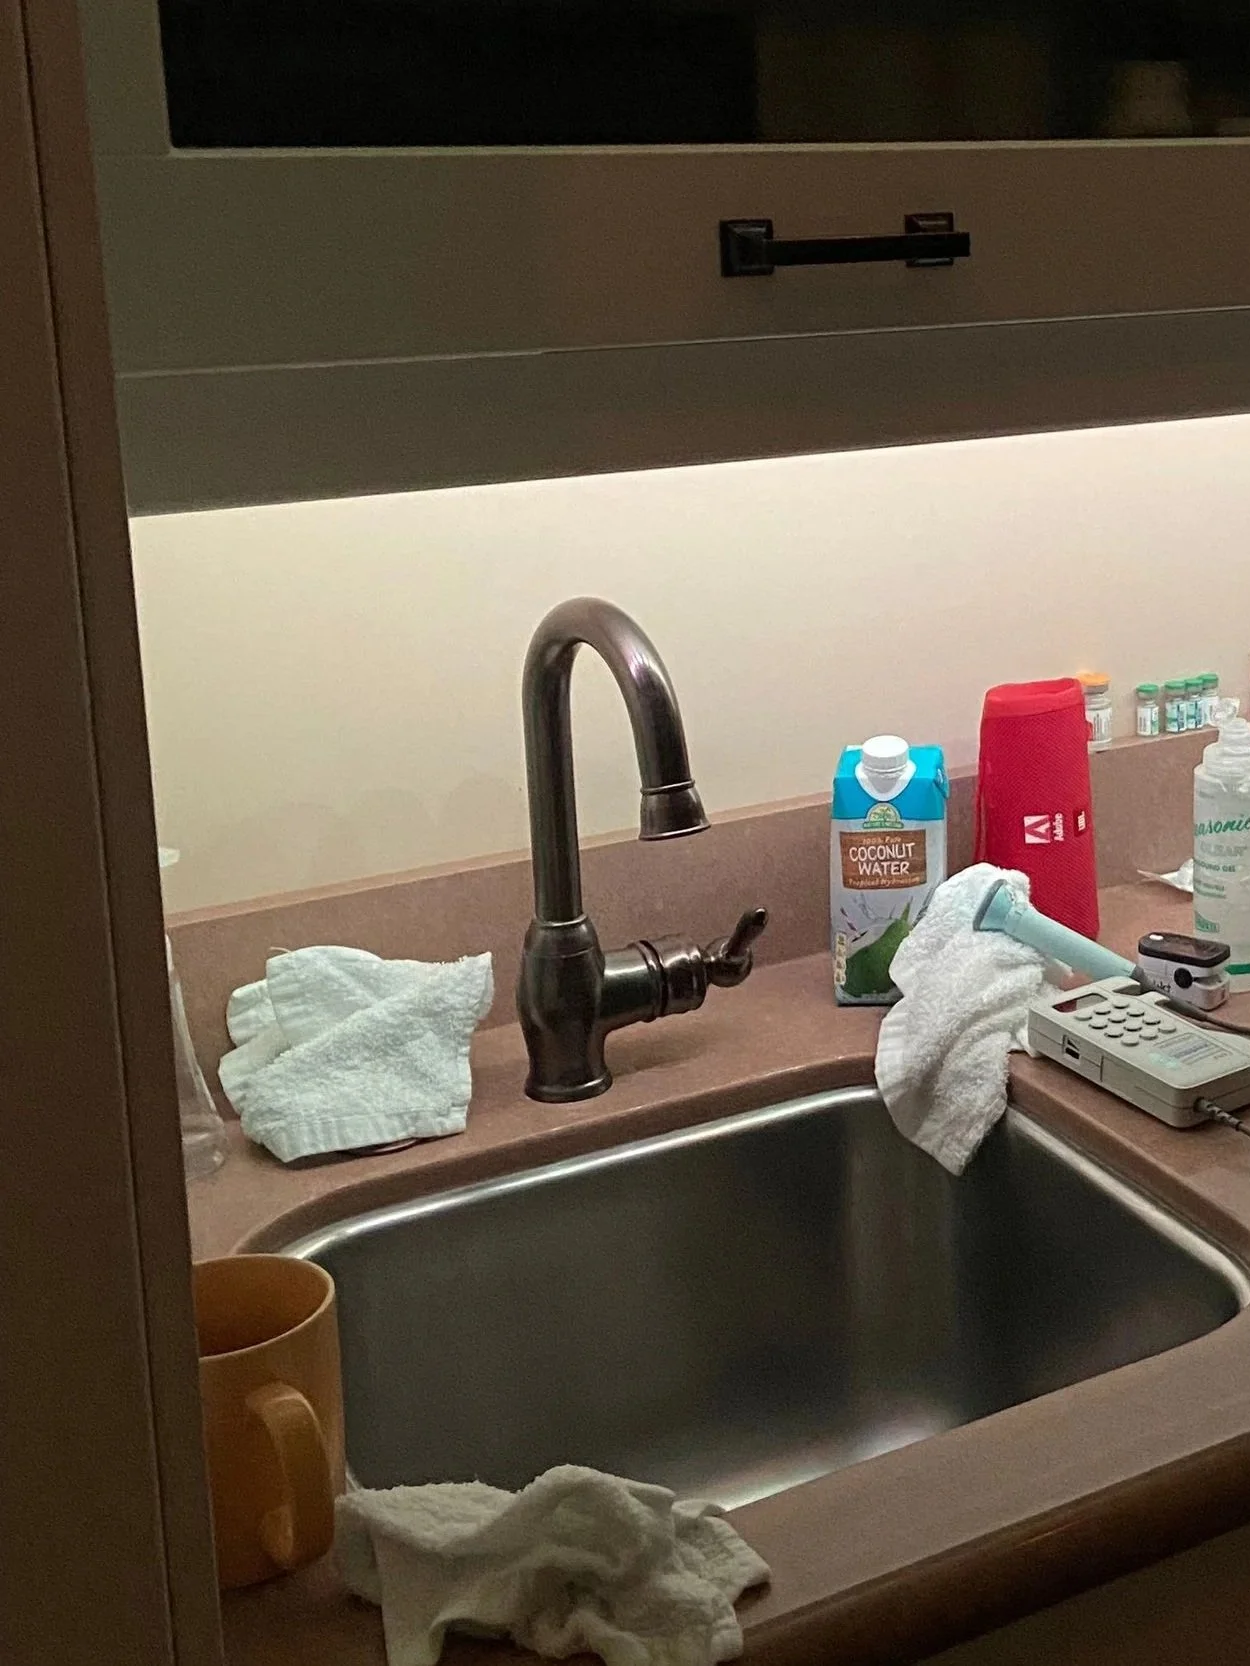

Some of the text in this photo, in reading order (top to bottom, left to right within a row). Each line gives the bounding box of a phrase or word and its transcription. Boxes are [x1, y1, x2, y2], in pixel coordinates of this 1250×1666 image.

[1052, 812, 1065, 842] Adobe
[849, 842, 916, 862] COCONUT
[858, 861, 910, 876] WATER
